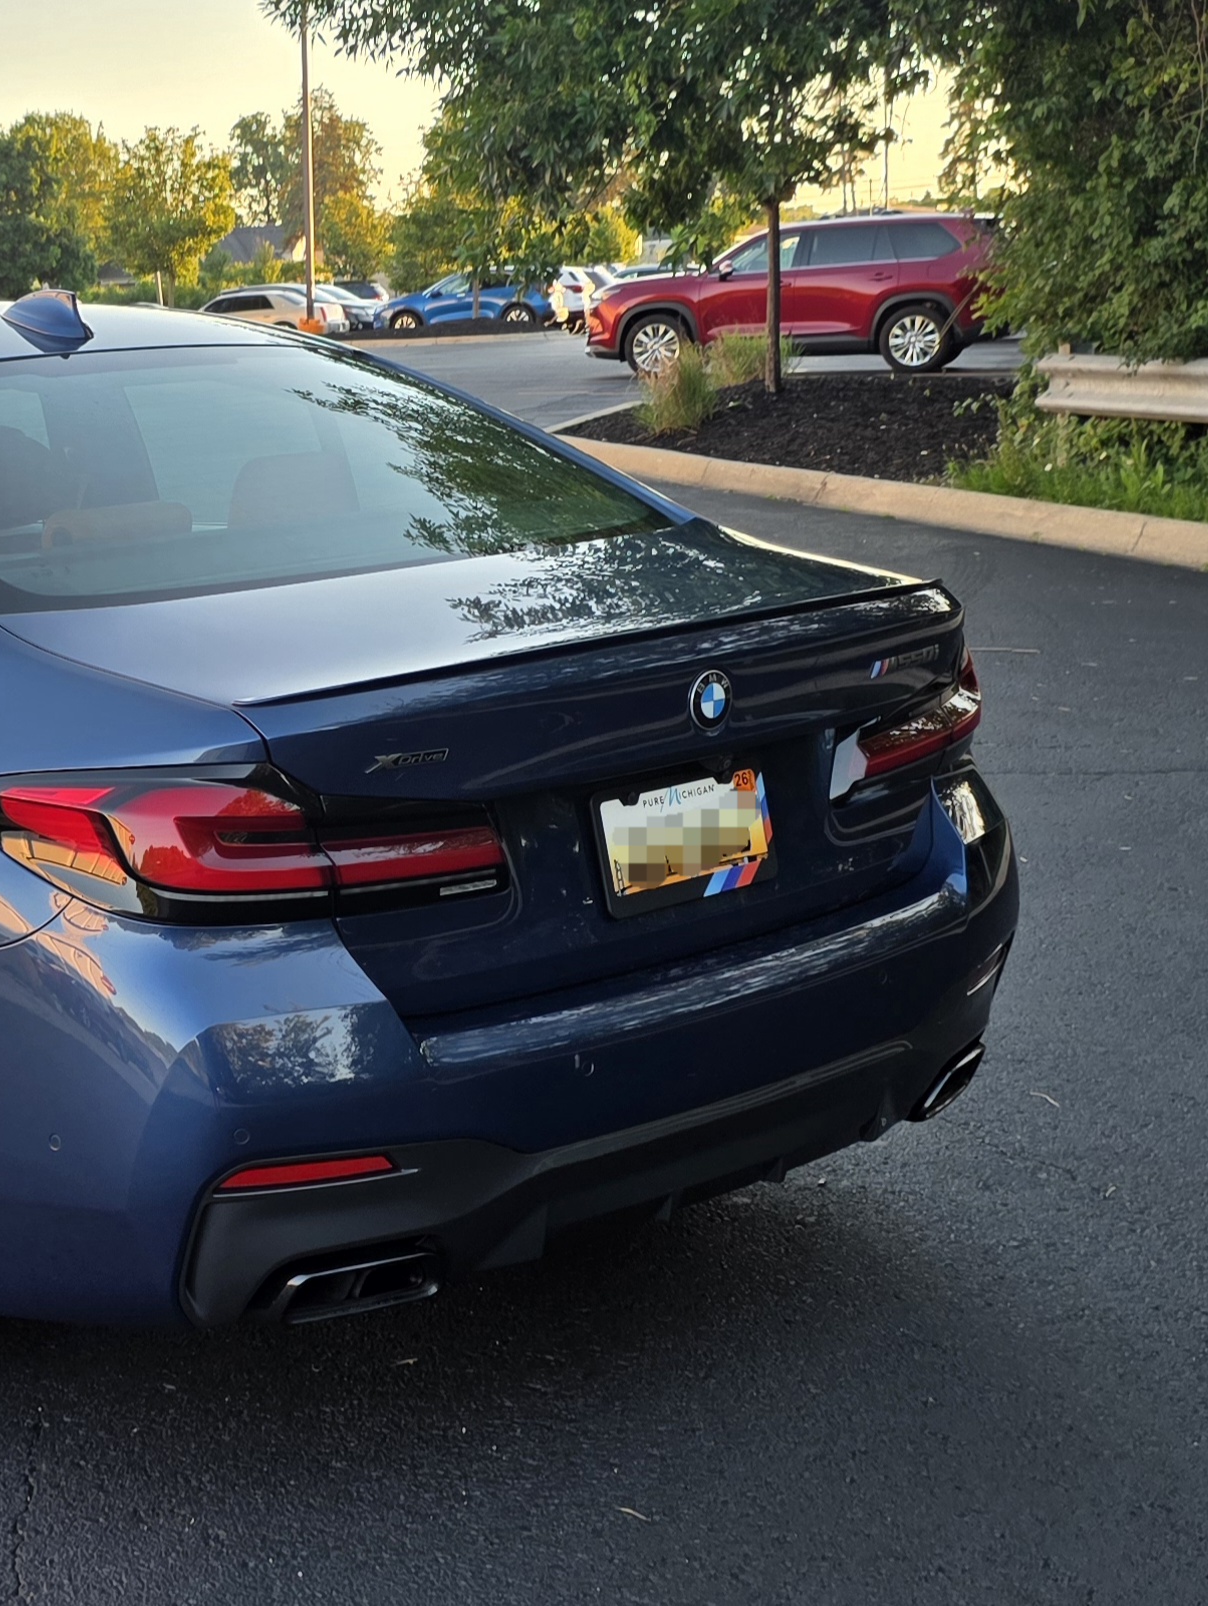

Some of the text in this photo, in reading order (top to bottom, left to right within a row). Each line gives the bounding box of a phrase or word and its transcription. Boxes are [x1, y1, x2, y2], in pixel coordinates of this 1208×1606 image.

[696, 673, 729, 694] BMW
[734, 772, 749, 787] 26
[643, 785, 715, 810] PURE MICHIGAN
